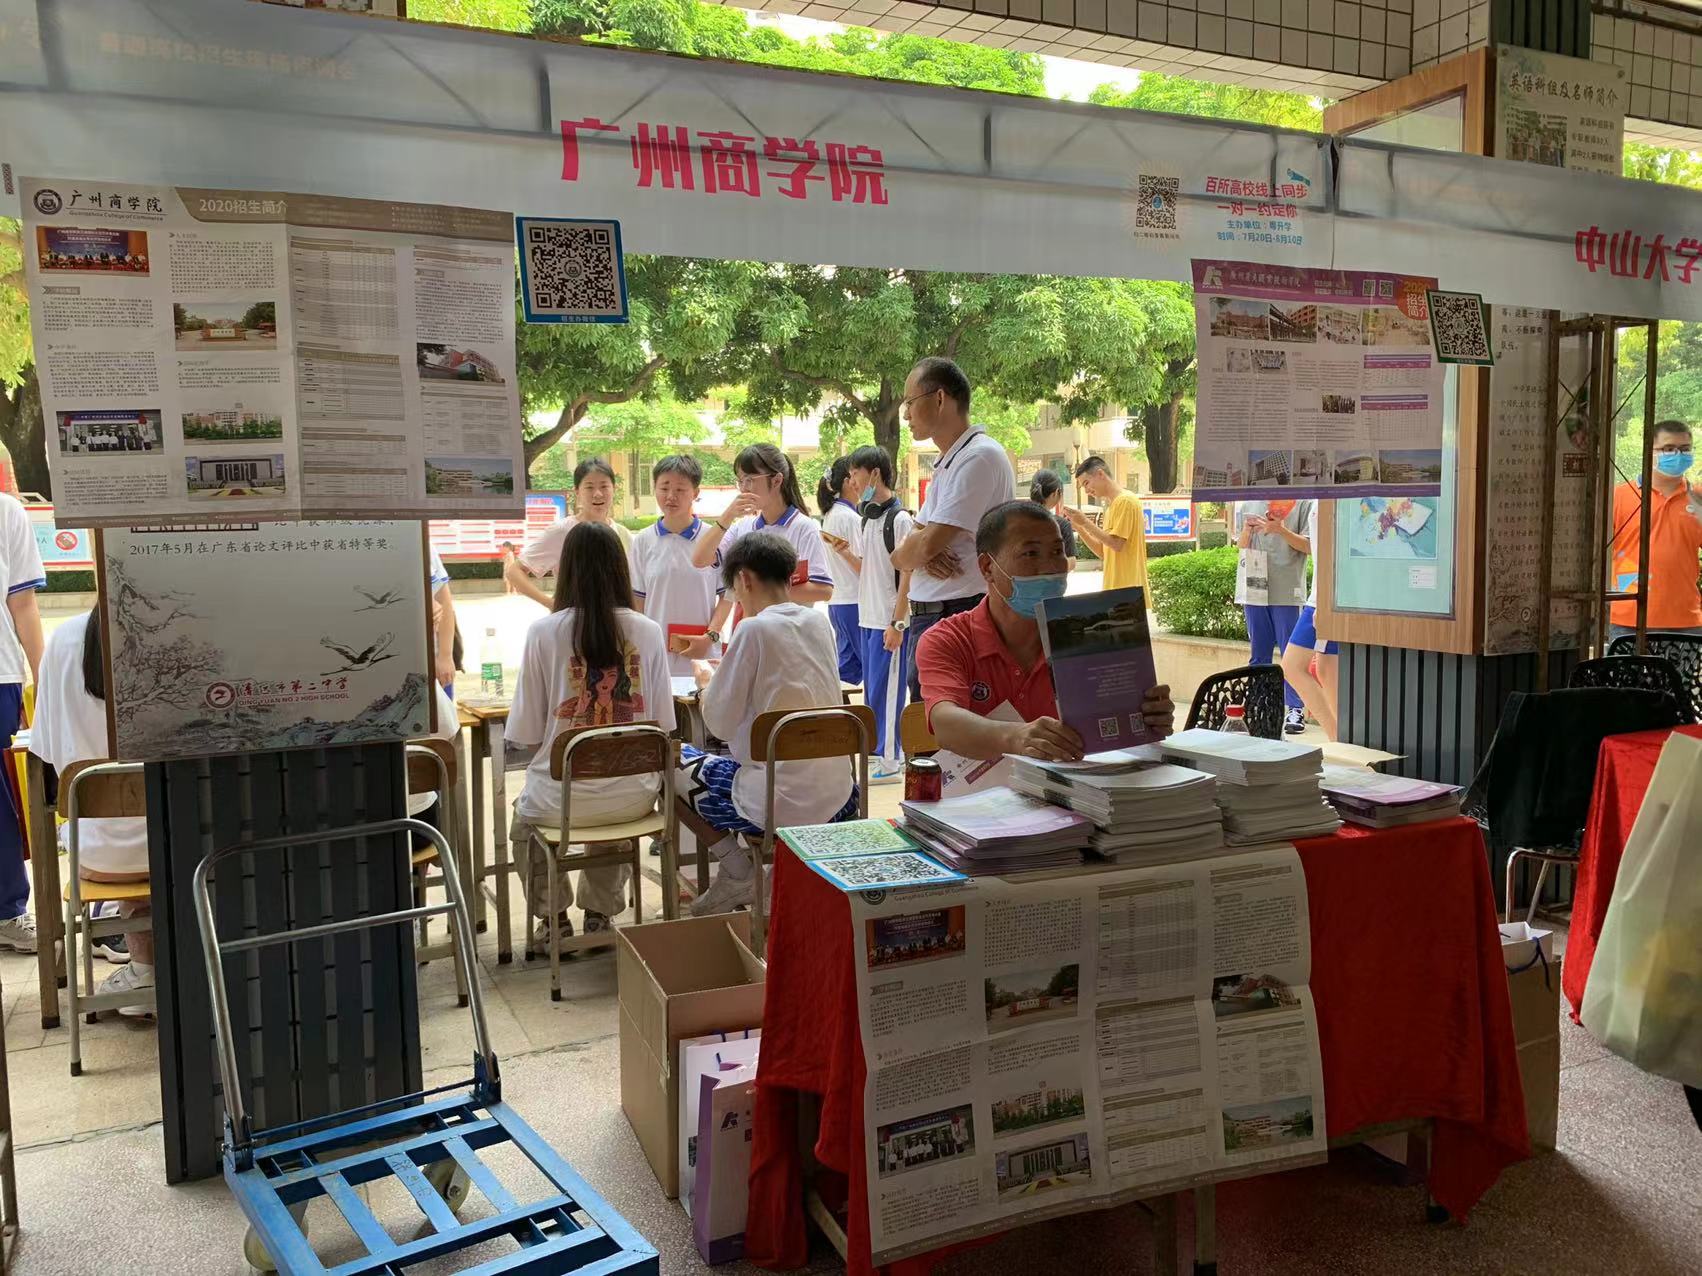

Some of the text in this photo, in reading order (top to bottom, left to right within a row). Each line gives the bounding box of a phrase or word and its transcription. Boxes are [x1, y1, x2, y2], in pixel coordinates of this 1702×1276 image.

[1509, 71, 1619, 107] 英语科组及名师简介
[561, 118, 889, 204] 广州商学院
[1205, 176, 1308, 199] 百所高校线上同步
[70, 189, 162, 212] 广州商学院
[200, 199, 288, 215] 2020招生简介
[1217, 201, 1298, 219] 一对一约定你
[1575, 226, 1702, 284] 中山大学
